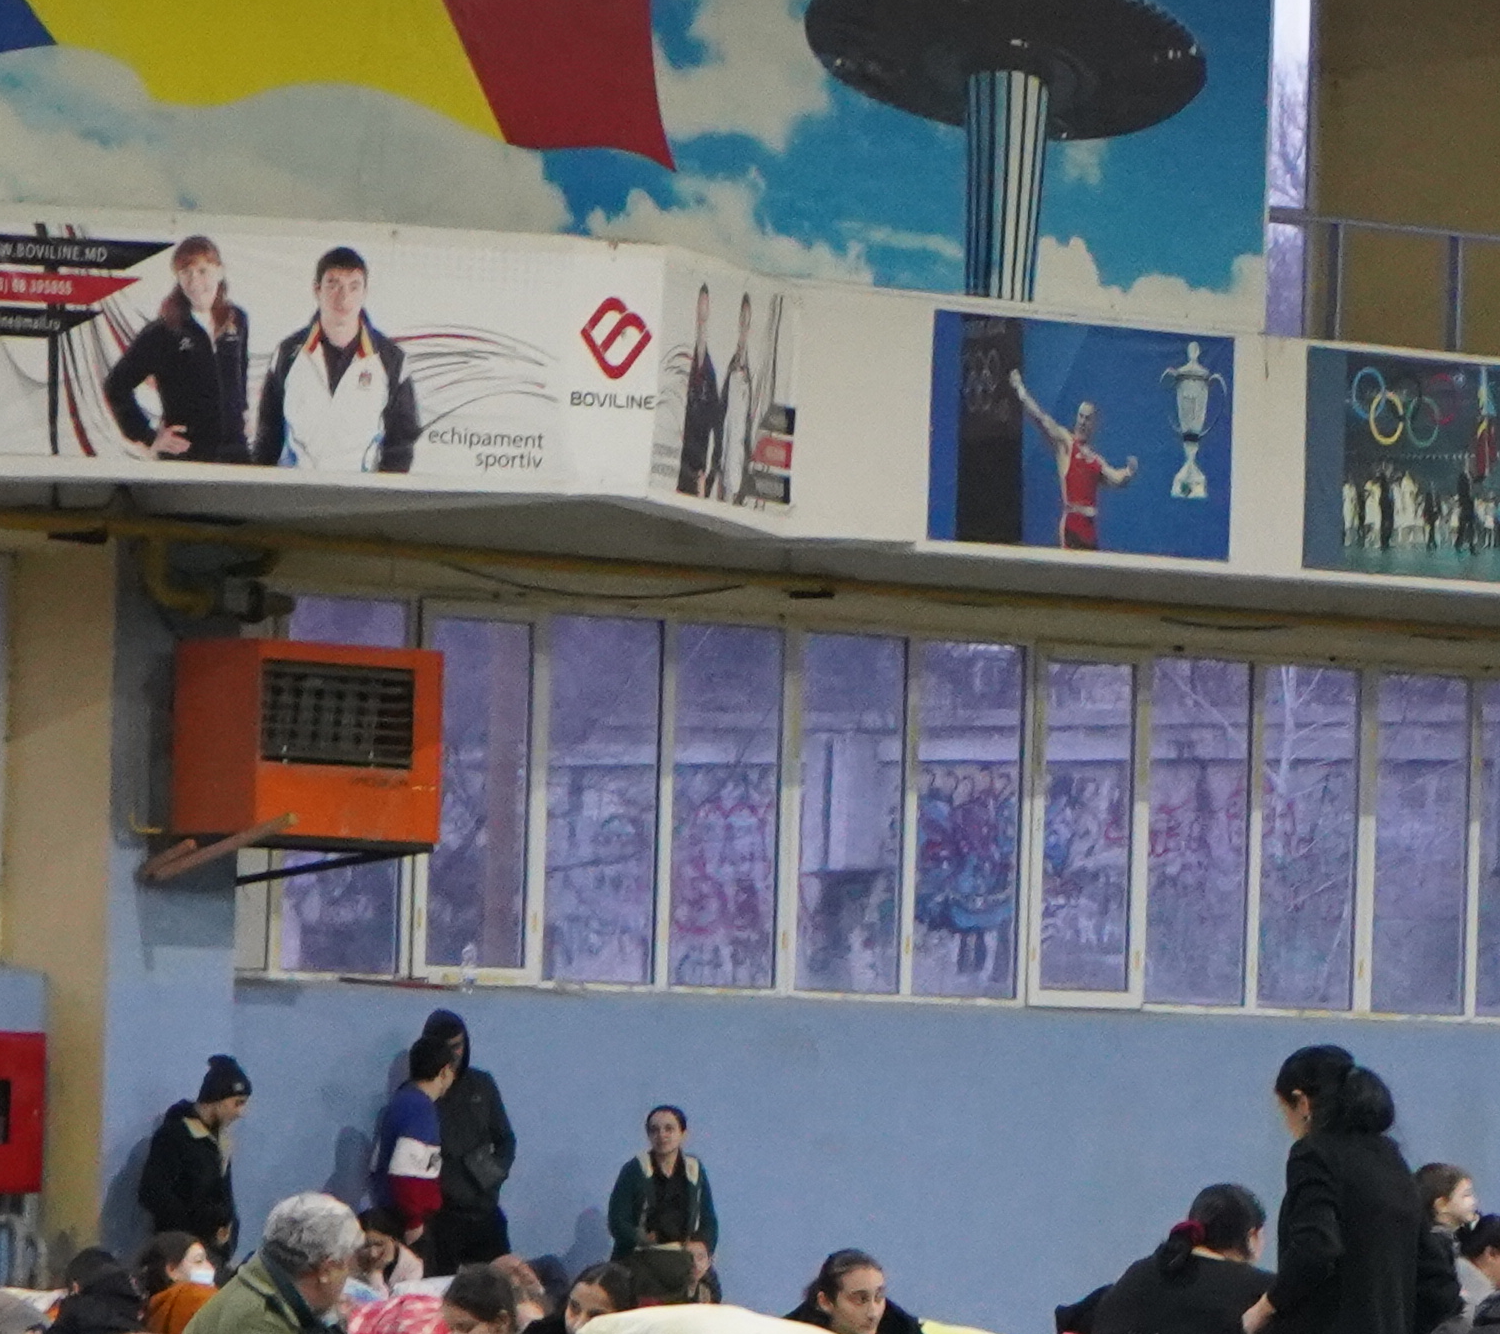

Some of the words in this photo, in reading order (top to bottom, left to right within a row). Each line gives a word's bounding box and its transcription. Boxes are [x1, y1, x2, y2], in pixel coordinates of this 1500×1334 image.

[570, 390, 655, 410] BOVILINE
[428, 425, 544, 450] echipament
[475, 451, 543, 471] sportiv
